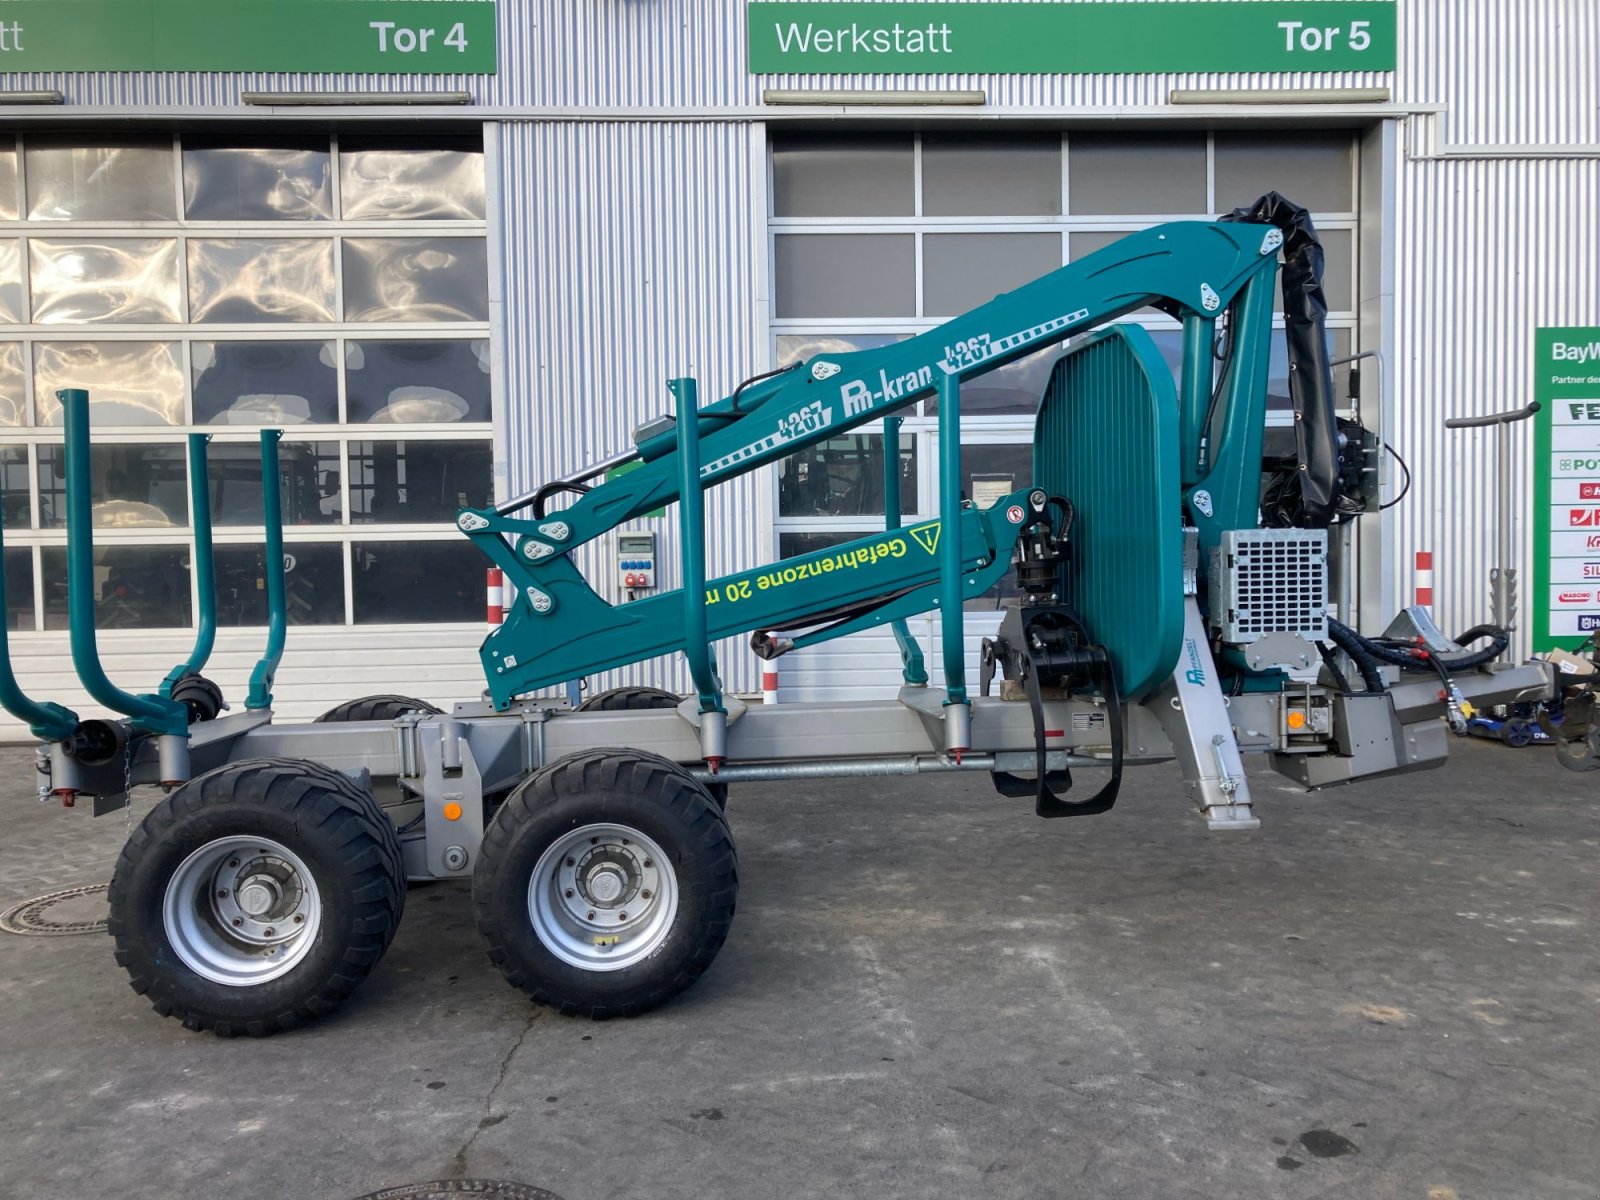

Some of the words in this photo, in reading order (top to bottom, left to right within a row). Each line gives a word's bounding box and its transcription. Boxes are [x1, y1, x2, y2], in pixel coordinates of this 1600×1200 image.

[369, 21, 435, 52] Tor
[443, 22, 468, 52] 4
[775, 23, 952, 52] Werkstatt
[1278, 21, 1340, 51] Tor
[1348, 21, 1371, 51] 5
[944, 333, 992, 369] 4267
[1552, 375, 1585, 384] Partner
[778, 399, 825, 440] 4267
[757, 539, 907, 589] Gefahrenzone
[726, 580, 752, 602] 20
